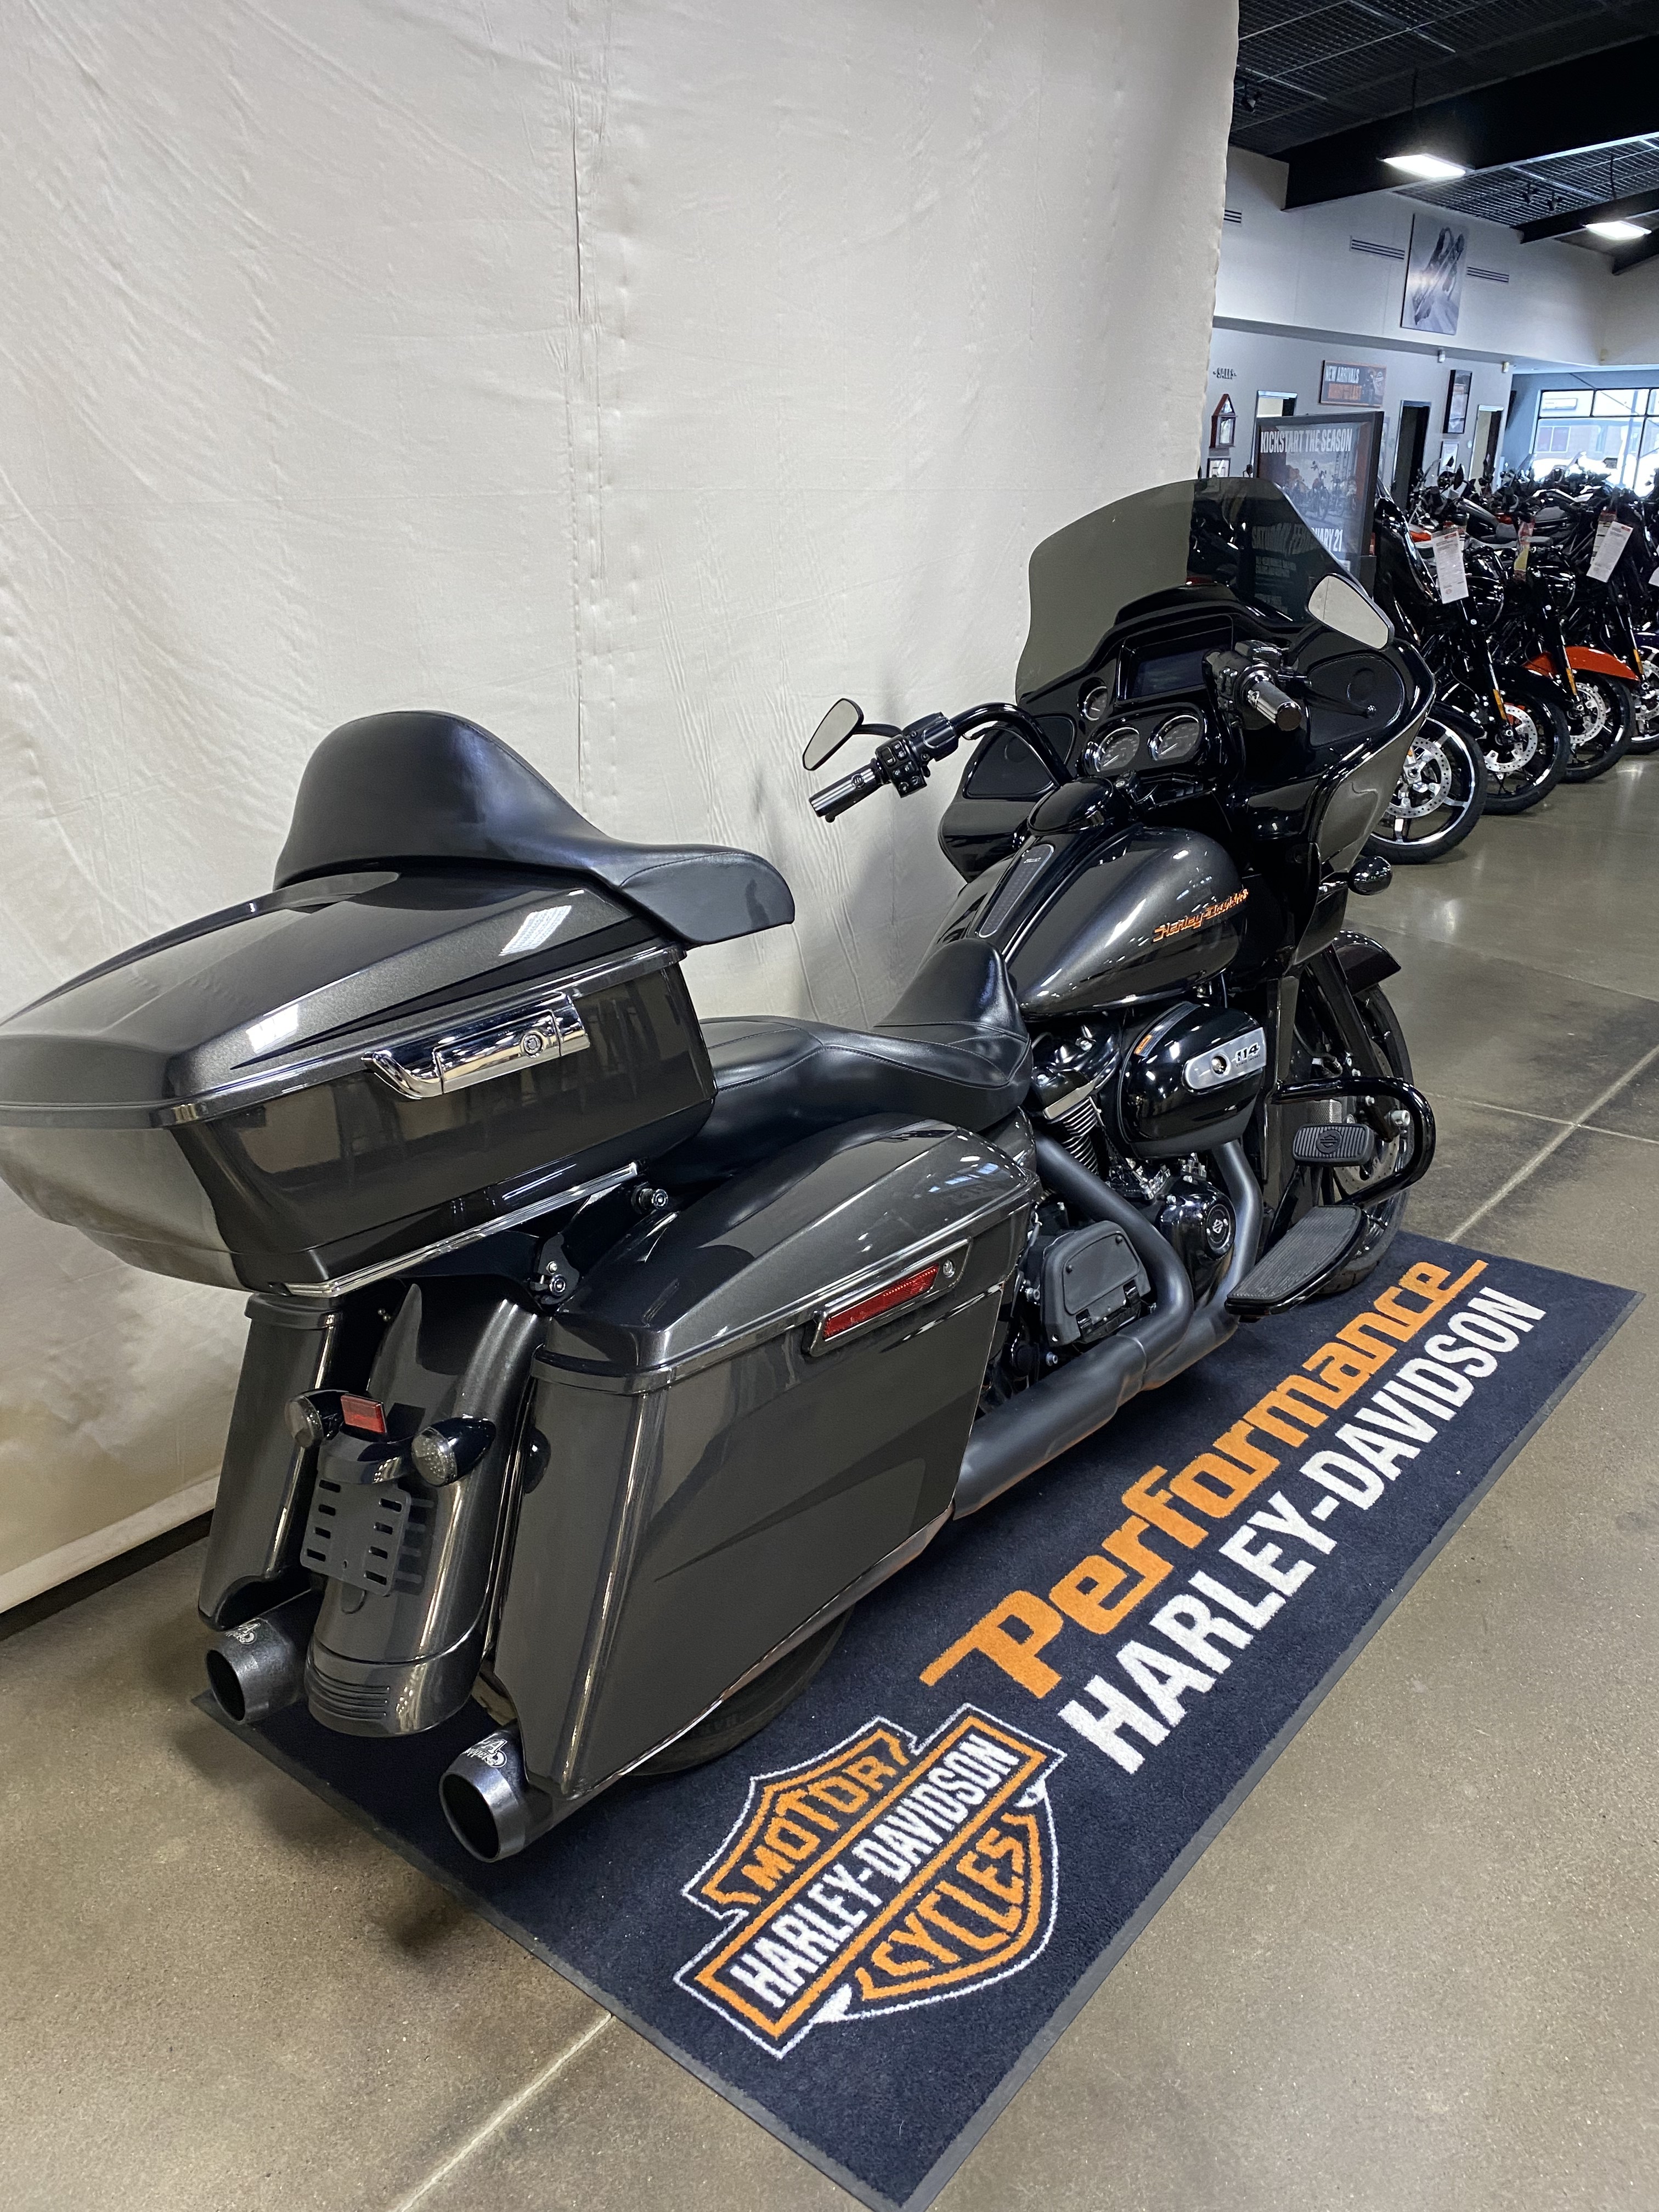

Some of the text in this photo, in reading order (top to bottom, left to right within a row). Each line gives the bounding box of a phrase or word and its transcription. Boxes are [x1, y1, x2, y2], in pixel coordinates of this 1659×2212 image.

[1260, 428, 1352, 453] KICKSTART THE SEASON
[1333, 529, 1344, 552] 21
[1232, 1042, 1260, 1063] 114
[919, 1260, 1487, 1699] Performance
[1058, 1286, 1547, 1775] HARLEY-DAVIDSON
[729, 1733, 1020, 2009] HARLEY-DAVIDSON
[742, 1756, 898, 1891] MOTOR
[871, 1827, 1025, 1976] CYCLES
